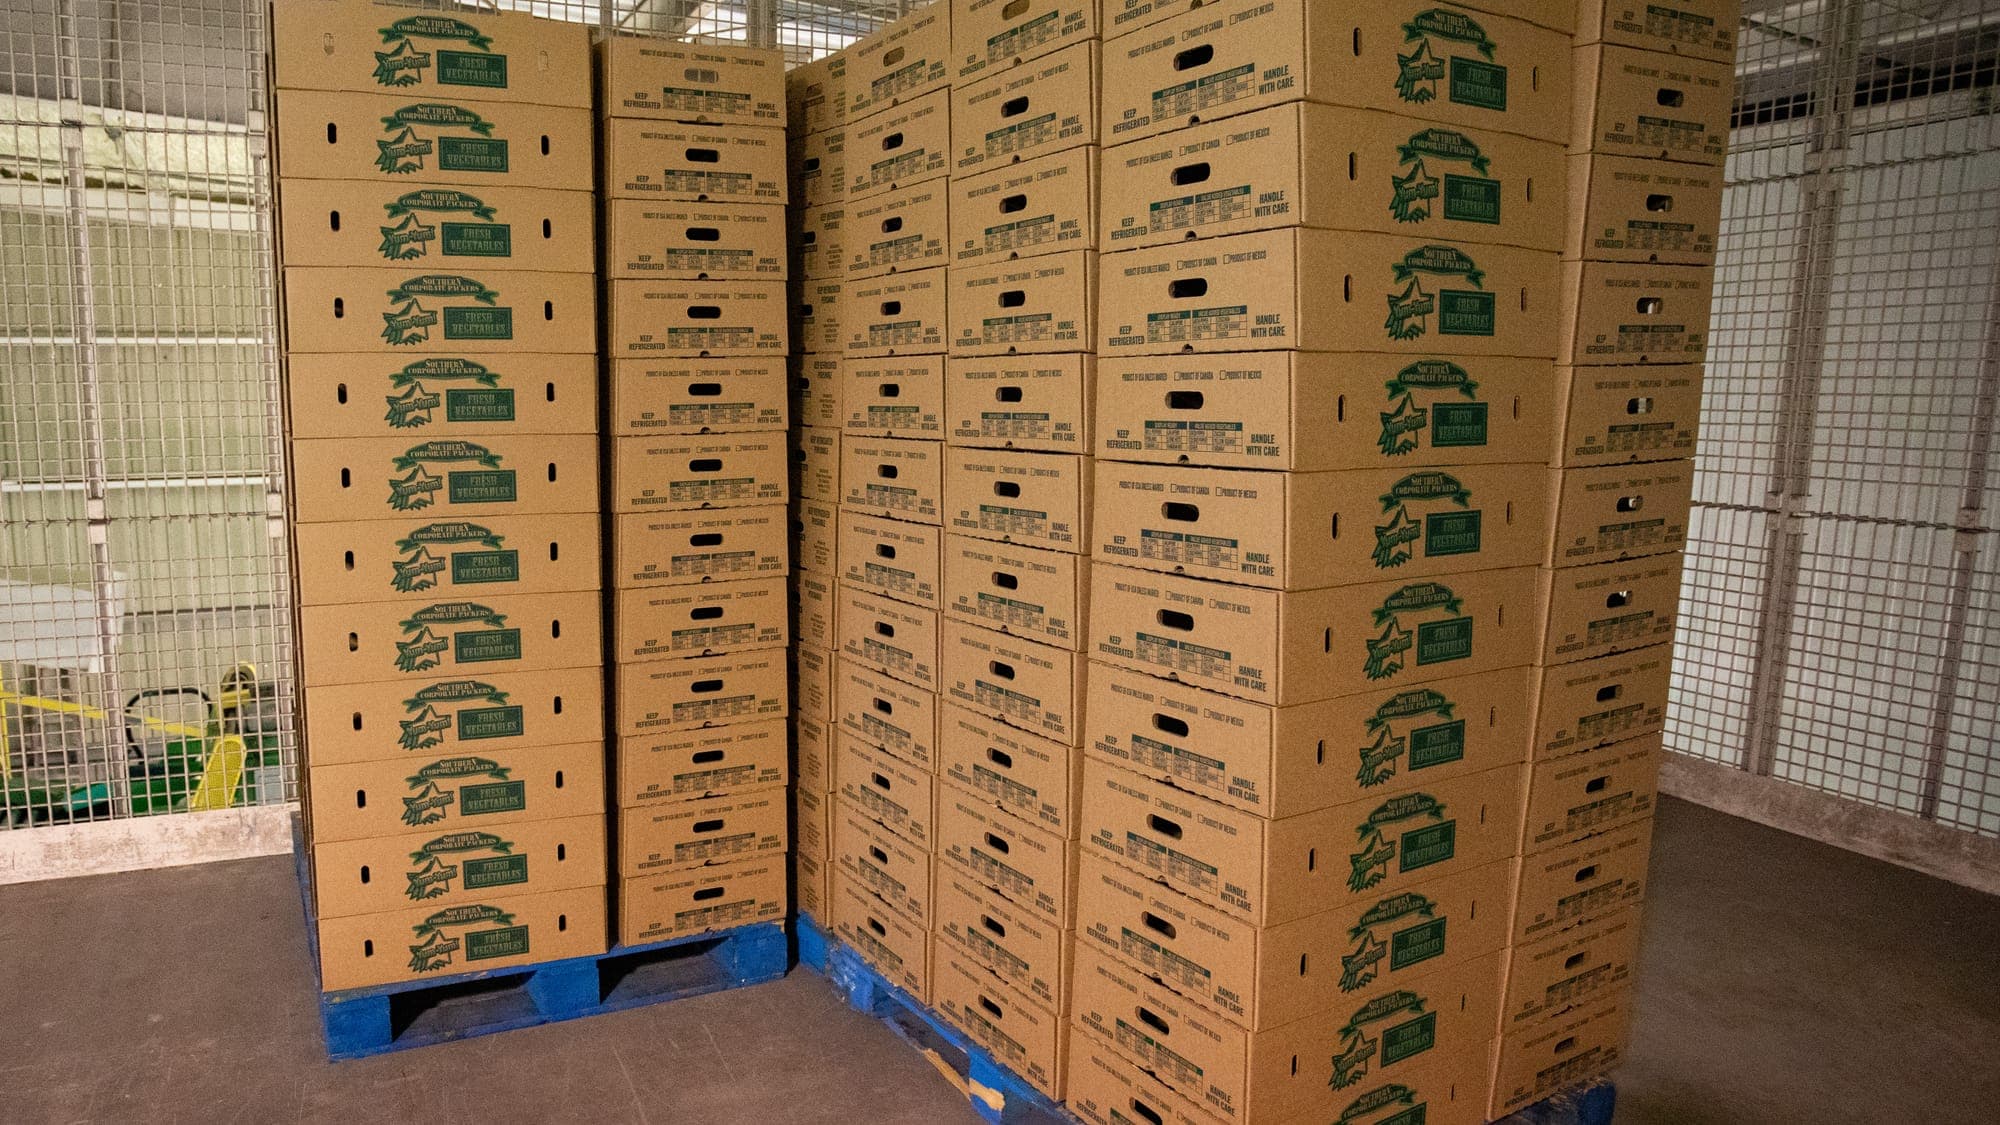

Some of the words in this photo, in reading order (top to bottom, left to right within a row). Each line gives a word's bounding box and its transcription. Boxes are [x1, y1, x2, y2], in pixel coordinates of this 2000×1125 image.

[415, 16, 456, 29] SOUTHERN
[397, 24, 437, 34] CORPORATE
[439, 26, 474, 37] PACKERS
[459, 56, 487, 70] FRESH
[444, 68, 501, 82] VEGETABLES
[1263, 64, 1289, 81] HANDLE
[1258, 81, 1275, 96] WITH
[1277, 76, 1294, 91] CARE
[1123, 107, 1137, 120] KEEP
[1113, 114, 1150, 134] REFRIGERATED
[420, 190, 460, 201] SOUTHERN
[1259, 190, 1284, 204] HANDLE
[402, 198, 441, 206] CORPORATE
[443, 199, 478, 208] PACKERS
[1254, 205, 1271, 218] WITH
[1272, 202, 1290, 215] CARE
[1121, 216, 1134, 228] KEEP
[463, 228, 491, 239] FRESH
[1111, 225, 1148, 240] REFRIGERATED
[449, 240, 505, 251] VEGETABLES
[627, 263, 664, 271] REFRIGERATED
[1255, 314, 1280, 325] HANDLE
[1119, 325, 1132, 335] KEEP
[1250, 327, 1267, 338] WITH
[1268, 326, 1286, 337] CARE
[1109, 334, 1145, 346] REFRIGERATED
[425, 359, 464, 368] SOUTHERN
[448, 367, 482, 375] PACKERS
[468, 394, 495, 405] FRESH
[454, 405, 509, 416] VEGETABLES
[962, 420, 971, 428] KEEP
[1055, 422, 1071, 431] HANDLE
[955, 429, 980, 438] REFRIGERATED
[1051, 432, 1064, 441] WITH
[1064, 433, 1076, 442] CARE
[1117, 430, 1129, 439] KEEP
[1251, 434, 1275, 444] HANDLE
[428, 442, 467, 450] SOUTHERN
[1106, 440, 1142, 450] REFRIGERATED
[1246, 446, 1262, 456] WITH
[1263, 446, 1280, 457] CARE
[470, 475, 497, 487] FRESH
[760, 483, 778, 491] HANDLE
[456, 486, 511, 498] VEGETABLES
[642, 489, 655, 497] KEEP
[631, 497, 668, 506] REFRIGERATED
[1113, 535, 1126, 545] KEEP
[1103, 544, 1138, 557] REFRIGERATED
[1246, 552, 1270, 564] HANDLE
[1241, 563, 1257, 575] WITH
[1258, 565, 1275, 577] CARE
[959, 595, 968, 604] KEEP
[434, 603, 472, 612] SOUTHERN
[952, 602, 976, 616] REFRIGERATED
[416, 612, 454, 620] CORPORATE
[1049, 617, 1065, 629] HANDLE
[760, 627, 778, 635] HANDLE
[1046, 626, 1057, 637] WITH
[1058, 629, 1069, 640] CARE
[475, 634, 502, 646] FRESH
[644, 639, 657, 647] KEEP
[1109, 635, 1122, 646] KEEP
[462, 644, 516, 657] VEGETABLES
[634, 646, 670, 656] REFRIGERATED
[1099, 643, 1134, 659] REFRIGERATED
[1239, 665, 1262, 680] HANDLE
[1234, 676, 1249, 688] WITH
[1250, 679, 1267, 693] CARE
[1105, 734, 1117, 746] KEEP
[1095, 741, 1129, 760] REFRIGERATED
[439, 758, 477, 768] SOUTHERN
[423, 766, 459, 776] CORPORATE
[461, 764, 494, 772] PACKERS
[761, 767, 778, 776] HANDLE
[647, 784, 659, 792] KEEP
[1232, 776, 1255, 792] HANDLE
[480, 786, 506, 799] FRESH
[636, 790, 671, 801] REFRIGERATED
[1227, 786, 1243, 799] WITH
[1244, 791, 1260, 806] CARE
[467, 795, 520, 810] VEGETABLES
[1100, 828, 1113, 841] KEEP
[1091, 834, 1124, 856] REFRIGERATED
[1225, 882, 1247, 900] HANDLE
[1220, 891, 1235, 906] WITH
[1236, 898, 1252, 914] CARE
[445, 905, 482, 916] SOUTHERN
[429, 914, 465, 924] CORPORATE
[466, 911, 498, 920] PACKERS
[1096, 921, 1108, 935] KEEP
[485, 931, 510, 944] FRESH
[1086, 926, 1119, 951] REFRIGERATED
[472, 940, 524, 955] VEGETABLES
[1218, 985, 1240, 1005] HANDLE
[1213, 994, 1228, 1010] WITH
[1229, 1002, 1244, 1019] CARE
[1090, 1010, 1102, 1024] KEEP
[1081, 1013, 1113, 1041] REFRIGERATED
[1210, 1084, 1231, 1105] HANDLE
[1205, 1092, 1219, 1108] WITH
[1221, 1101, 1236, 1119] CARE
